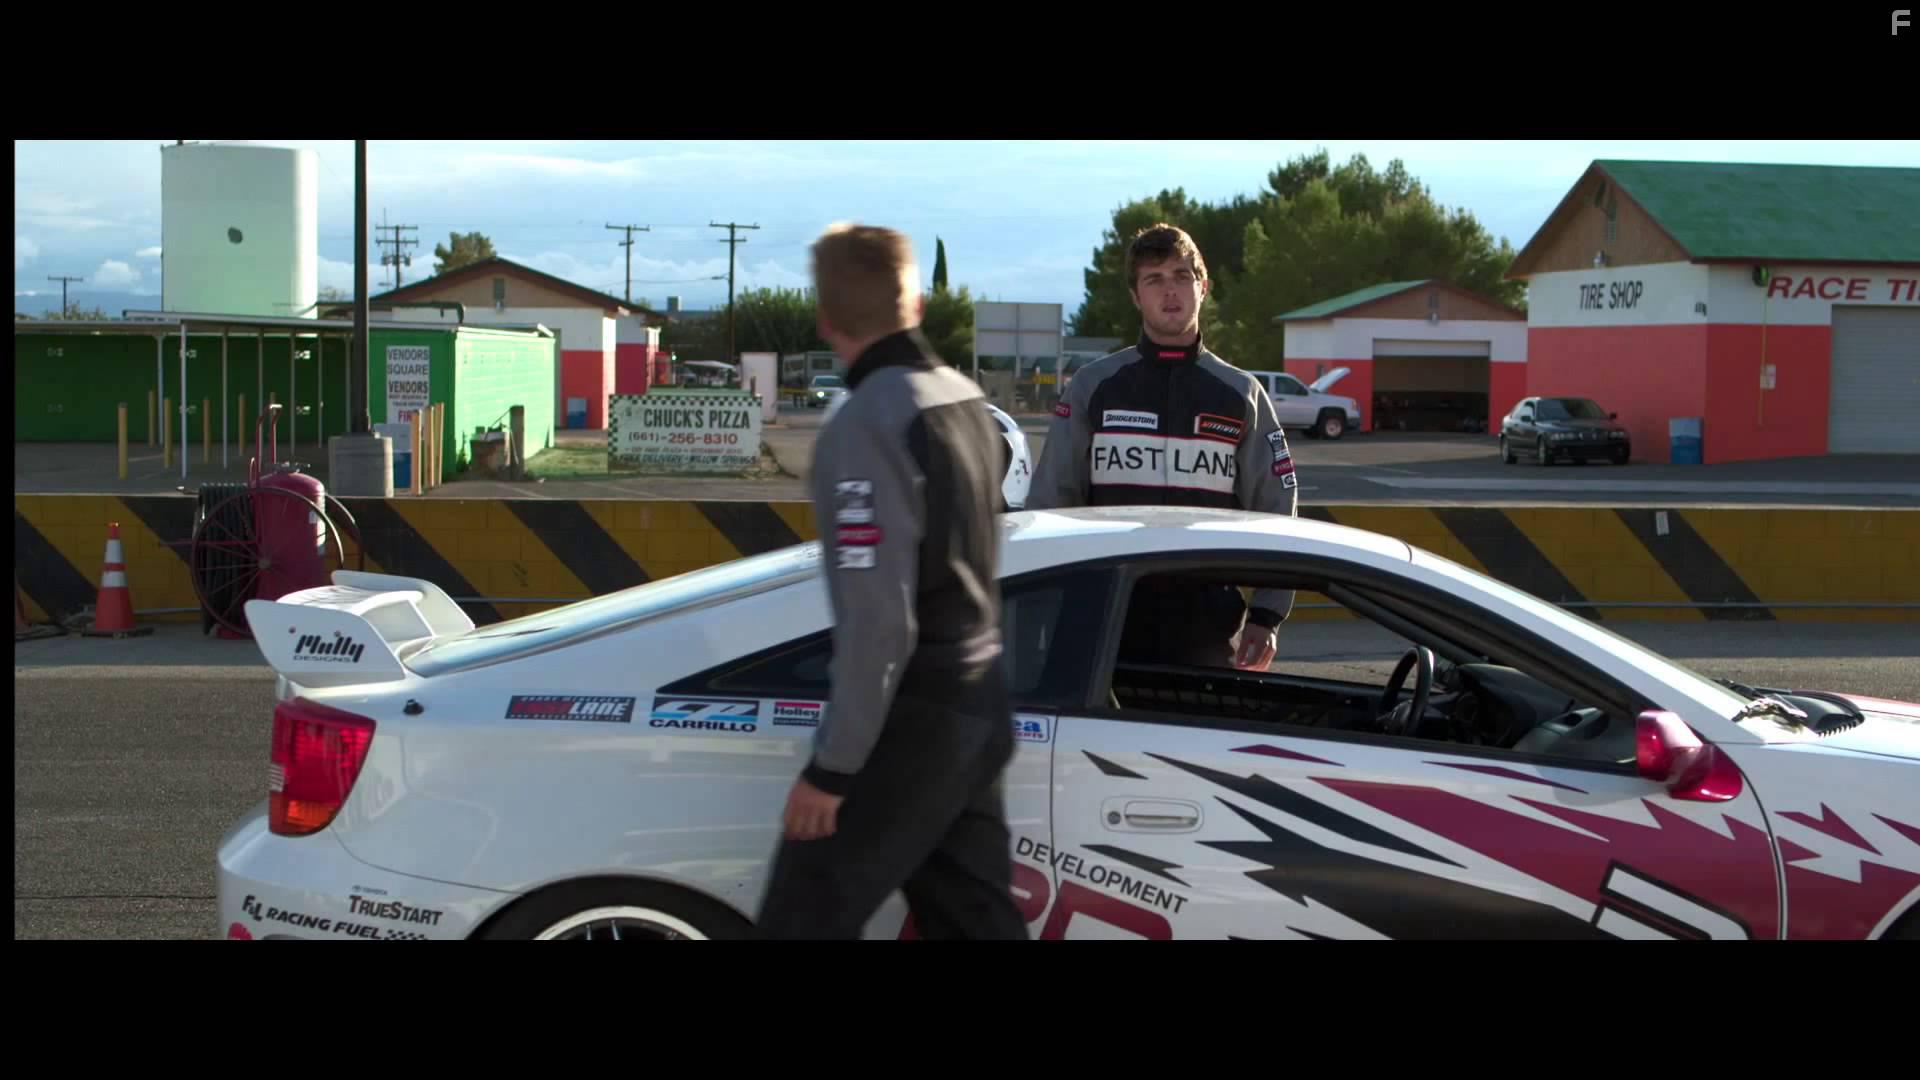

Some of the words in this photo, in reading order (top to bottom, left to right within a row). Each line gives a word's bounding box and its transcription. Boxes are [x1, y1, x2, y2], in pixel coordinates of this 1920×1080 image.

[1579, 282, 1605, 310] TIRE
[1609, 280, 1643, 310] SHOP
[1767, 276, 1871, 300] RACE
[1887, 278, 1920, 301] TI
[388, 348, 429, 361] VENDORS
[387, 363, 429, 375] SQUARE
[388, 381, 429, 393] VENDORS
[643, 408, 704, 428] CHUCK'S
[709, 410, 750, 429] PIZZA
[1105, 413, 1156, 425] BRIDGESTONE
[628, 431, 738, 445] (661)-256-8310
[1094, 446, 1164, 471] FAST
[1174, 448, 1235, 478] LANE
[293, 655, 351, 663] DESIGNS
[568, 701, 629, 716] LANE
[774, 706, 820, 719] Holley
[649, 718, 757, 733] CARRILLO
[1016, 836, 1189, 915] DEVELOPMENT
[265, 907, 331, 932] RACING
[333, 921, 383, 940] FUEL
